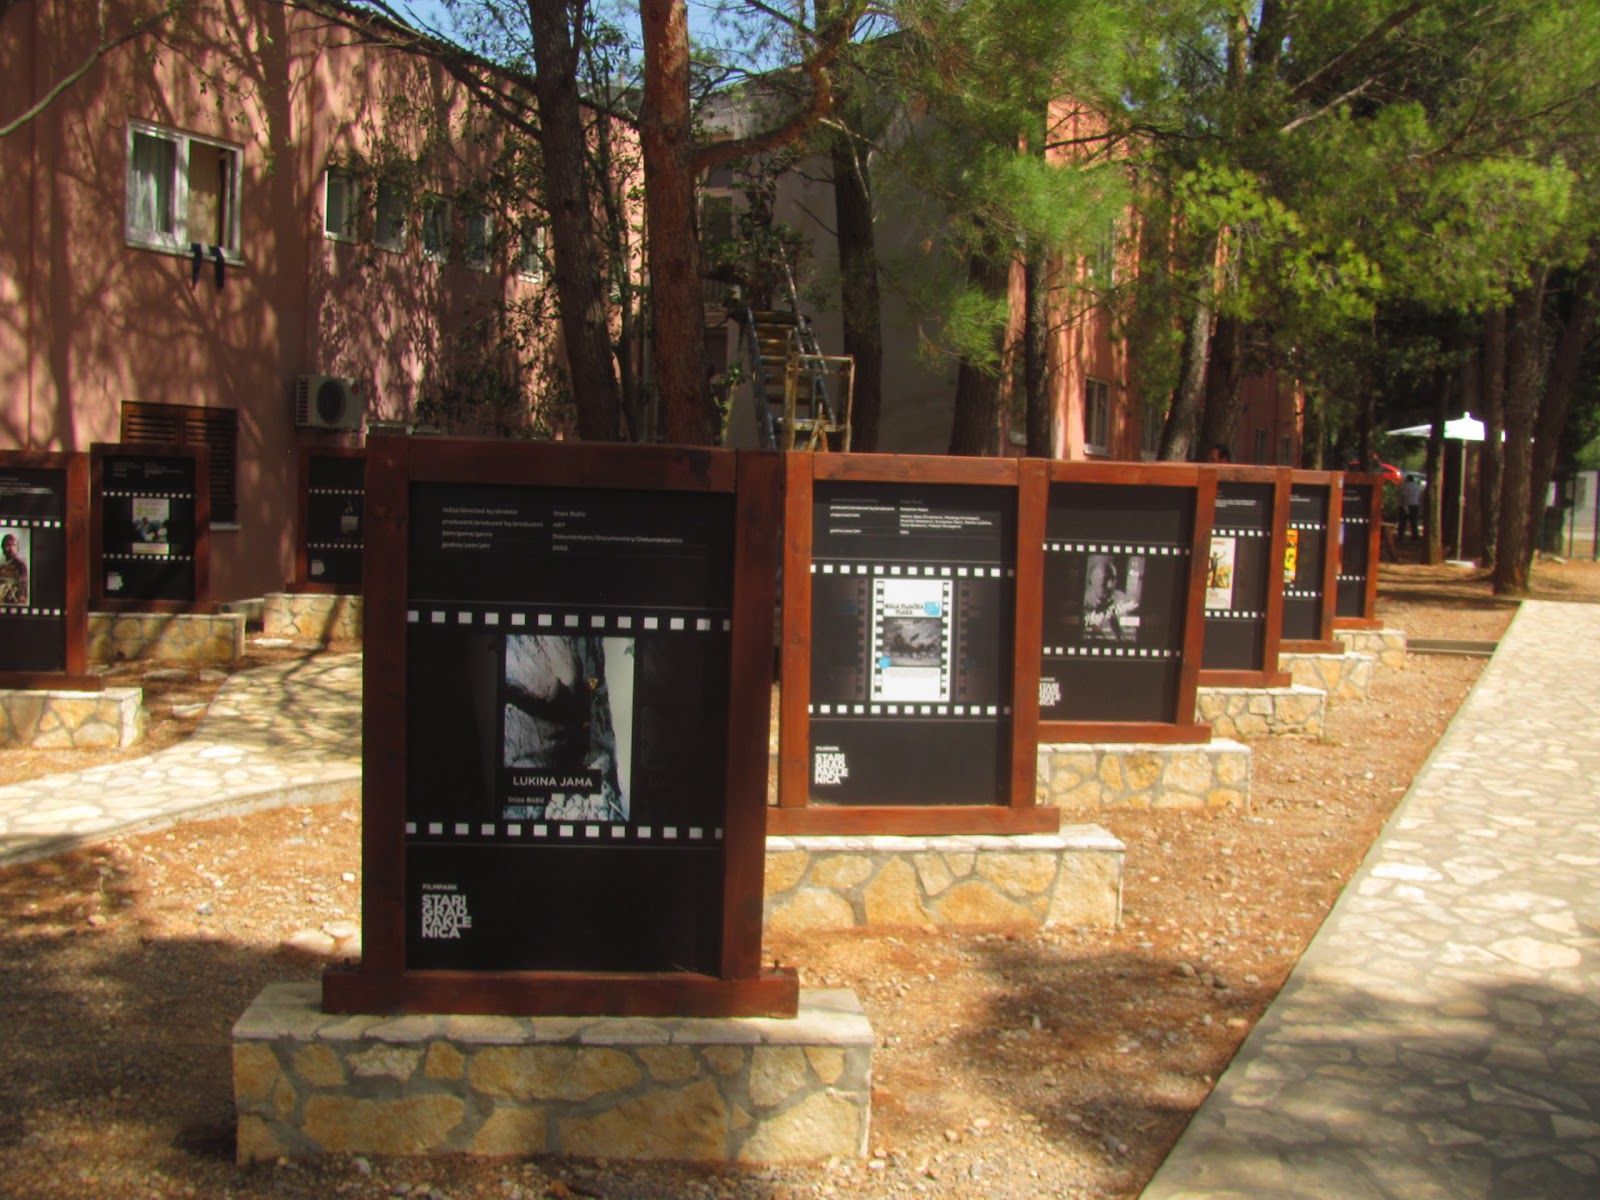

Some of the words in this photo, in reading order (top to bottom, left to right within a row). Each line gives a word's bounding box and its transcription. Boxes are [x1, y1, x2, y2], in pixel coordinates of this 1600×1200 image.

[513, 776, 557, 787] LUKINA
[559, 777, 593, 787] JAMA
[422, 894, 467, 906] STARI
[422, 905, 468, 917] GRAD
[422, 916, 472, 928] PAKLE
[422, 927, 461, 938] NICA
